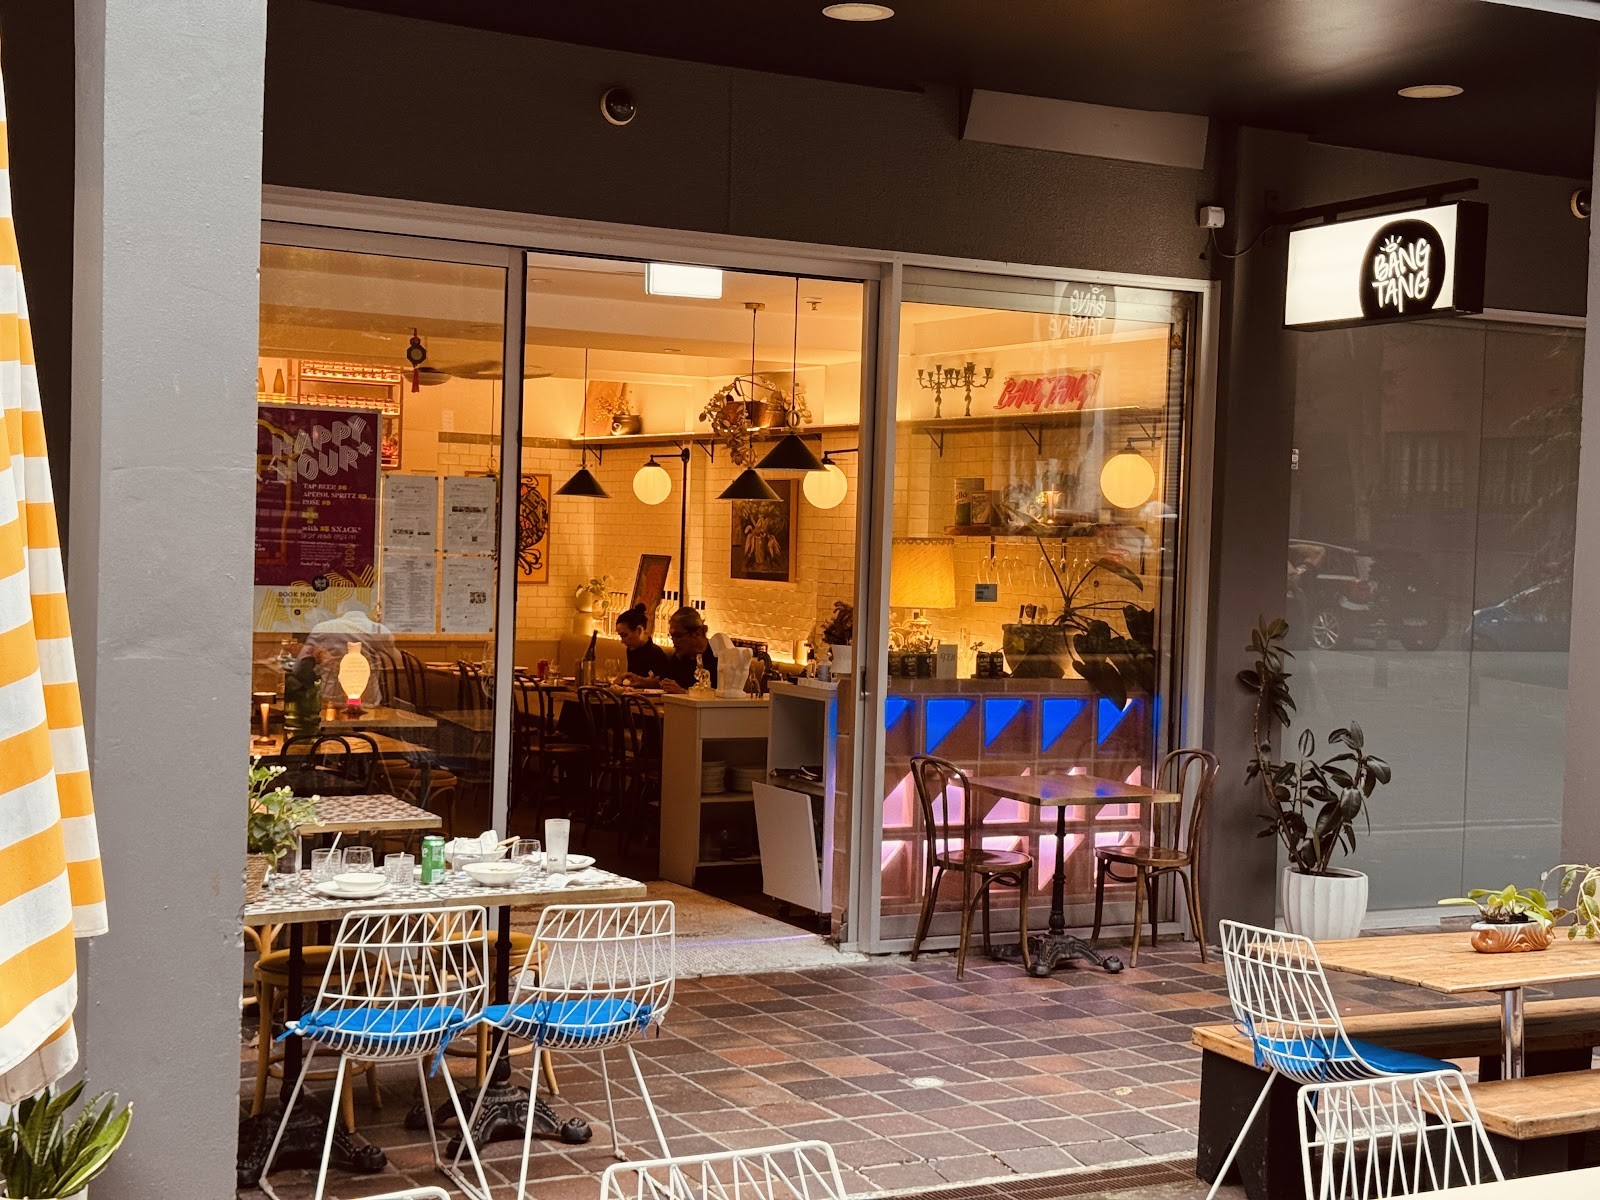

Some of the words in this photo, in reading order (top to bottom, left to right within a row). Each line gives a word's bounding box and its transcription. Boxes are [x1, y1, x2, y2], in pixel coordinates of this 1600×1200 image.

[1374, 237, 1431, 281] BANG
[1371, 271, 1430, 313] TANG
[272, 416, 367, 458] HAPPY
[277, 445, 359, 483] HOUR
